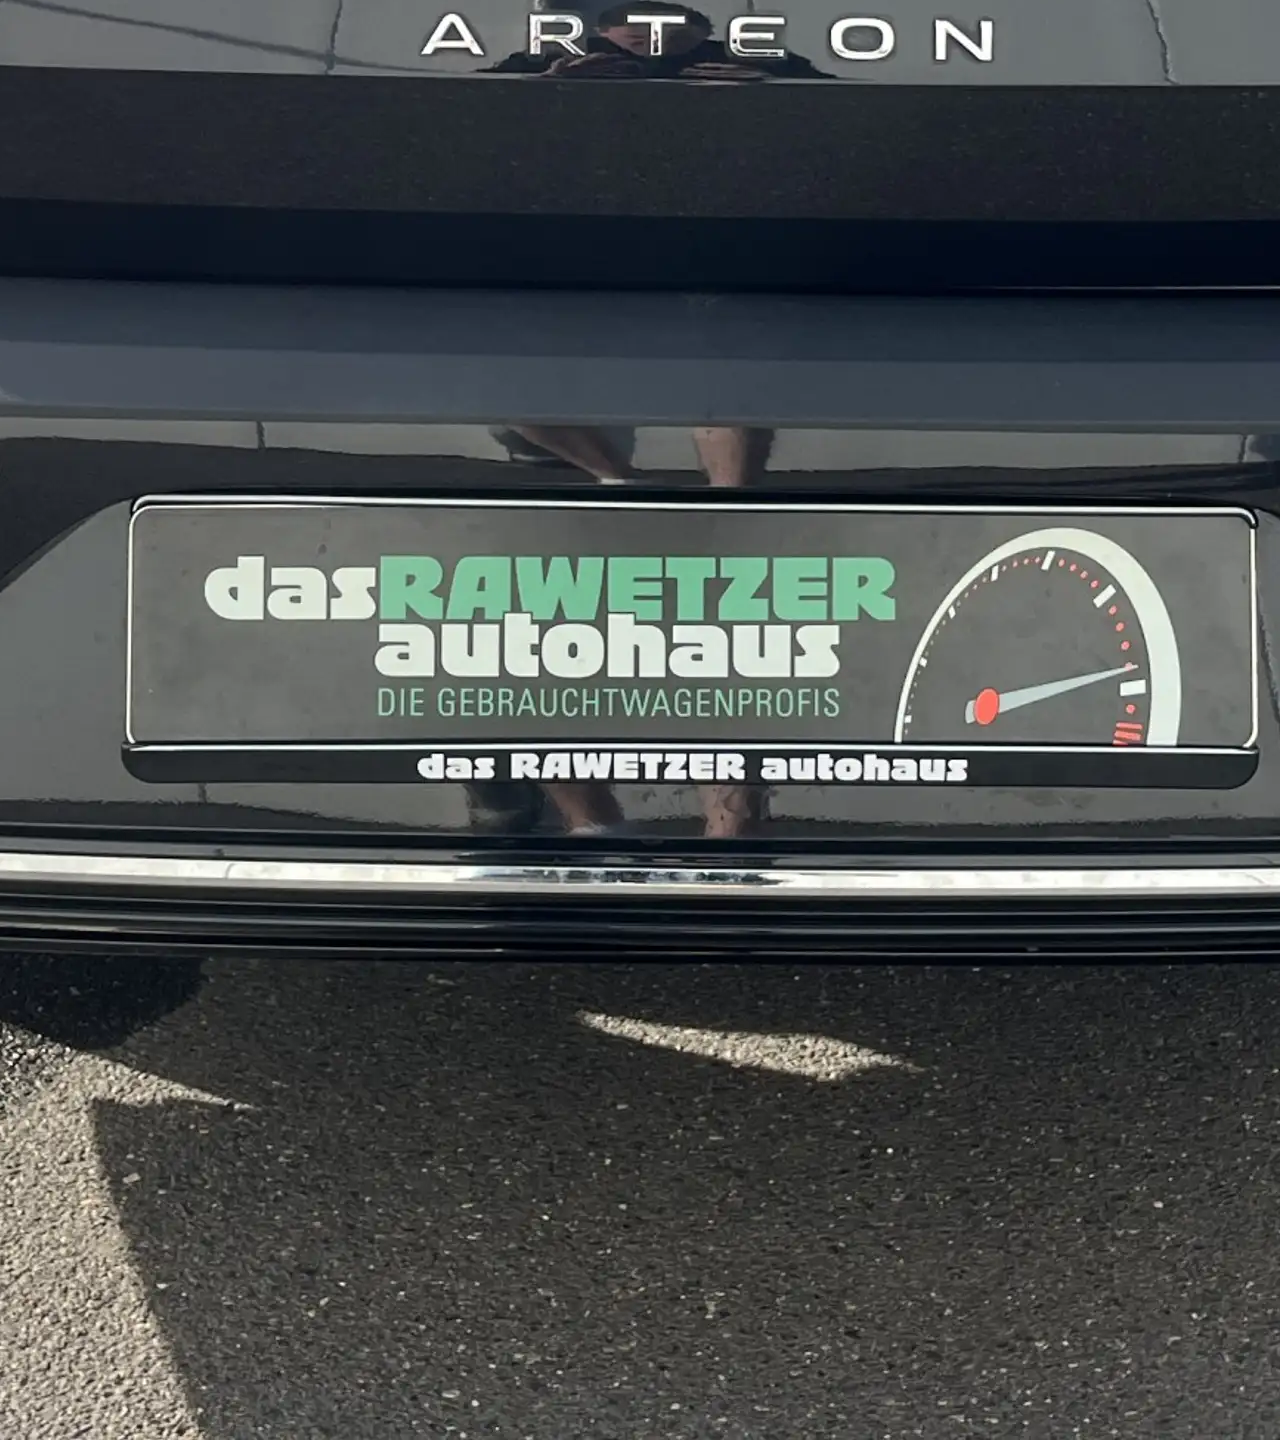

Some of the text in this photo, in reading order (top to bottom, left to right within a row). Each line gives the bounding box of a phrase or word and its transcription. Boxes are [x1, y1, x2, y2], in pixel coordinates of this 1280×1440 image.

[420, 12, 995, 62] ARTEON
[374, 612, 841, 678] autohaus
[377, 687, 841, 718] DIE GEBRAUCHTWAGENPROFIS
[416, 752, 969, 783] das RAWETZER autohaus
